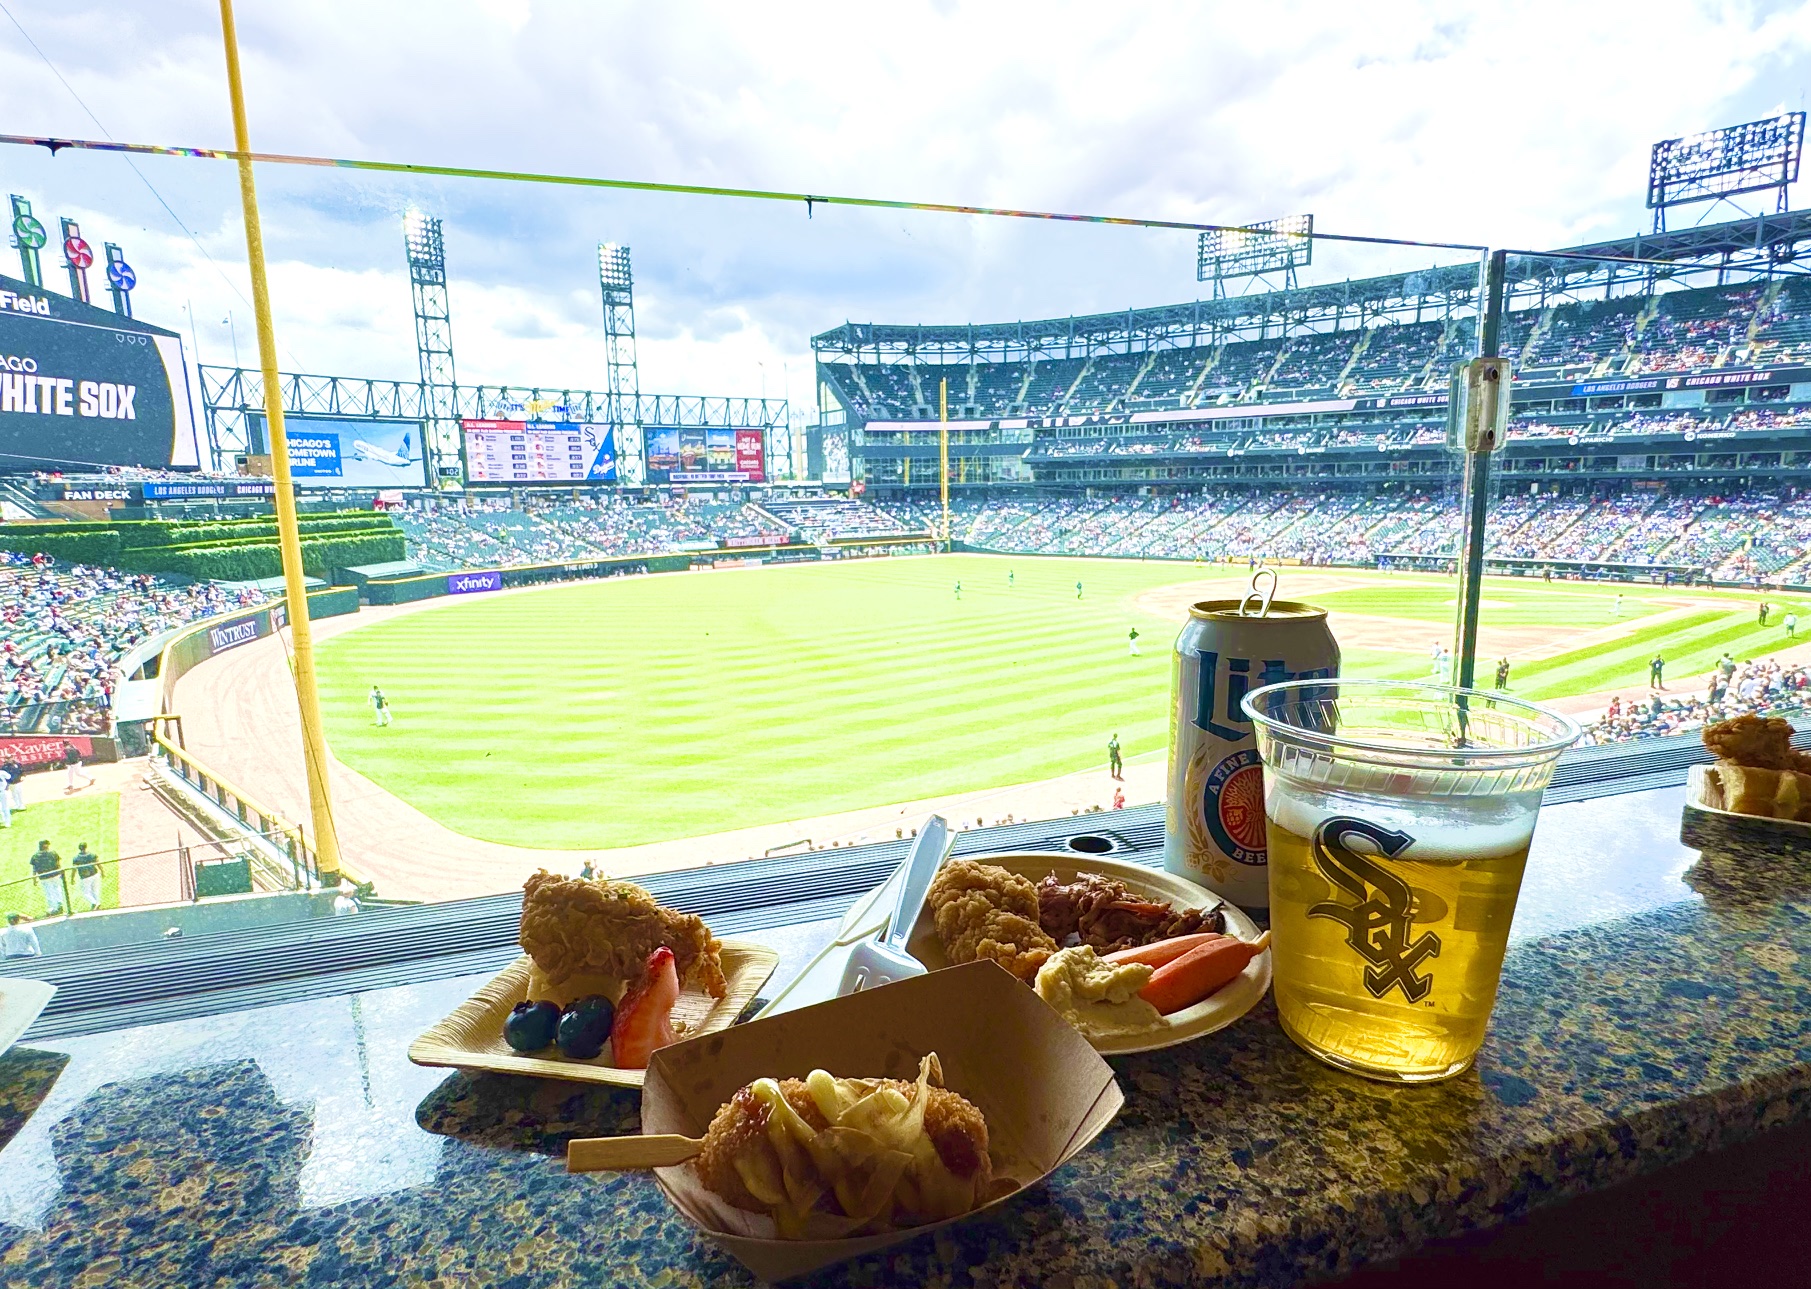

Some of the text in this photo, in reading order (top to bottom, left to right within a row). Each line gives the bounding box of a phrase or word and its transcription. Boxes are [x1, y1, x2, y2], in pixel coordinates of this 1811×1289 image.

[0, 290, 51, 316] Field
[1665, 378, 1680, 389] VS
[1723, 373, 1750, 384] WHITE
[1752, 371, 1771, 381] SOX
[0, 373, 136, 420] HITE SOX
[286, 438, 332, 449] HICAGO'S
[287, 449, 337, 458] OMETOWN
[289, 458, 317, 467] IRLINE
[65, 490, 131, 500] FAN DECK
[456, 576, 494, 591] xfinity
[210, 620, 256, 648] WINTRUST
[1191, 649, 1330, 742] Lite
[1209, 752, 1248, 796] A FINE
[1232, 849, 1267, 864] BEE
[1307, 815, 1441, 1004] Sox
